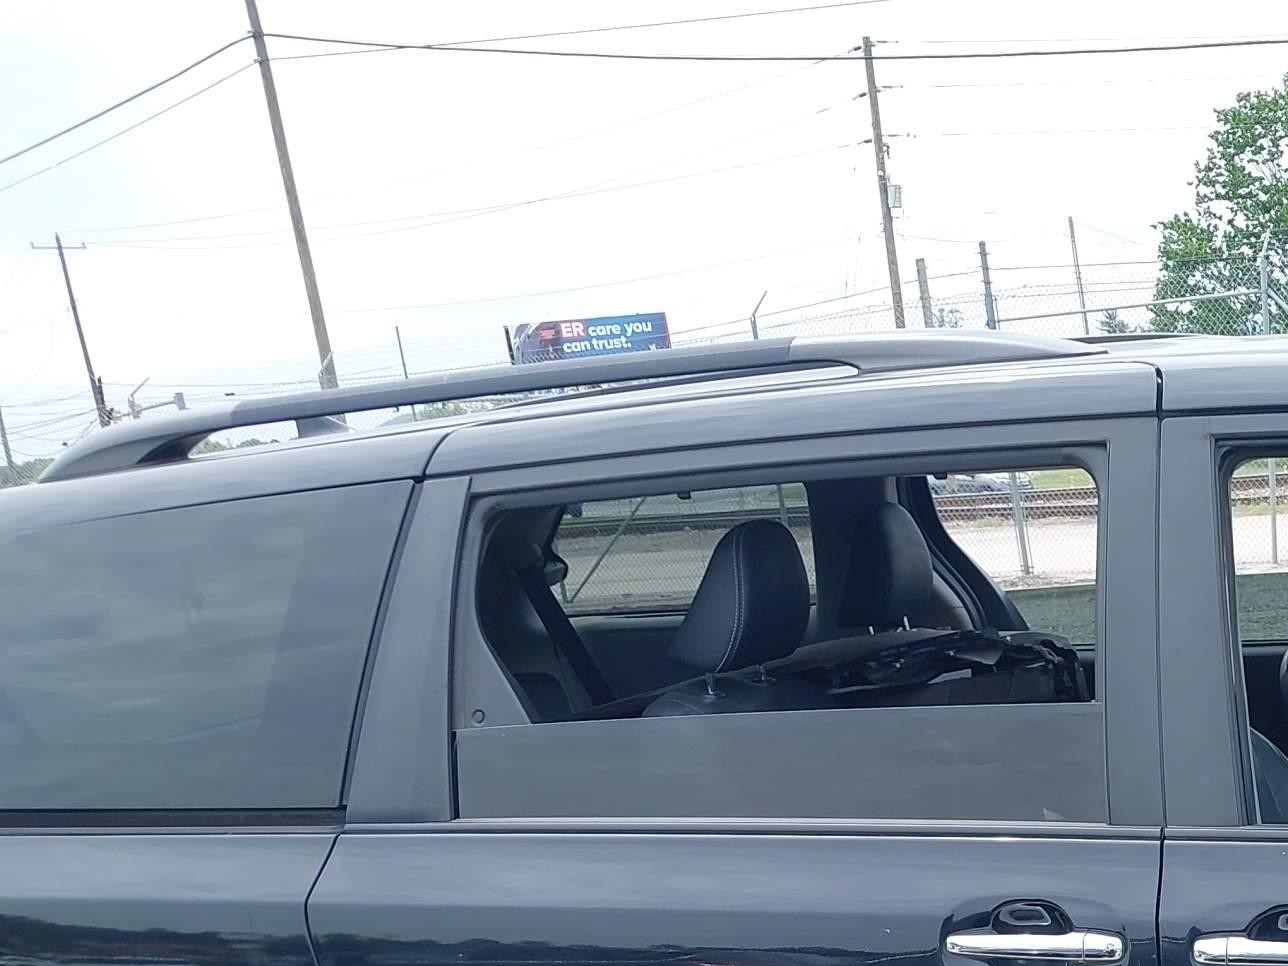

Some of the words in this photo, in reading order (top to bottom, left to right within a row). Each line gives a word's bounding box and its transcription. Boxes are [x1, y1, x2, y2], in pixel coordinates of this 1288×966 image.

[561, 322, 585, 338] ER
[588, 324, 621, 337] care
[624, 321, 652, 338] you
[563, 341, 590, 353] can
[592, 336, 632, 350] trust.
